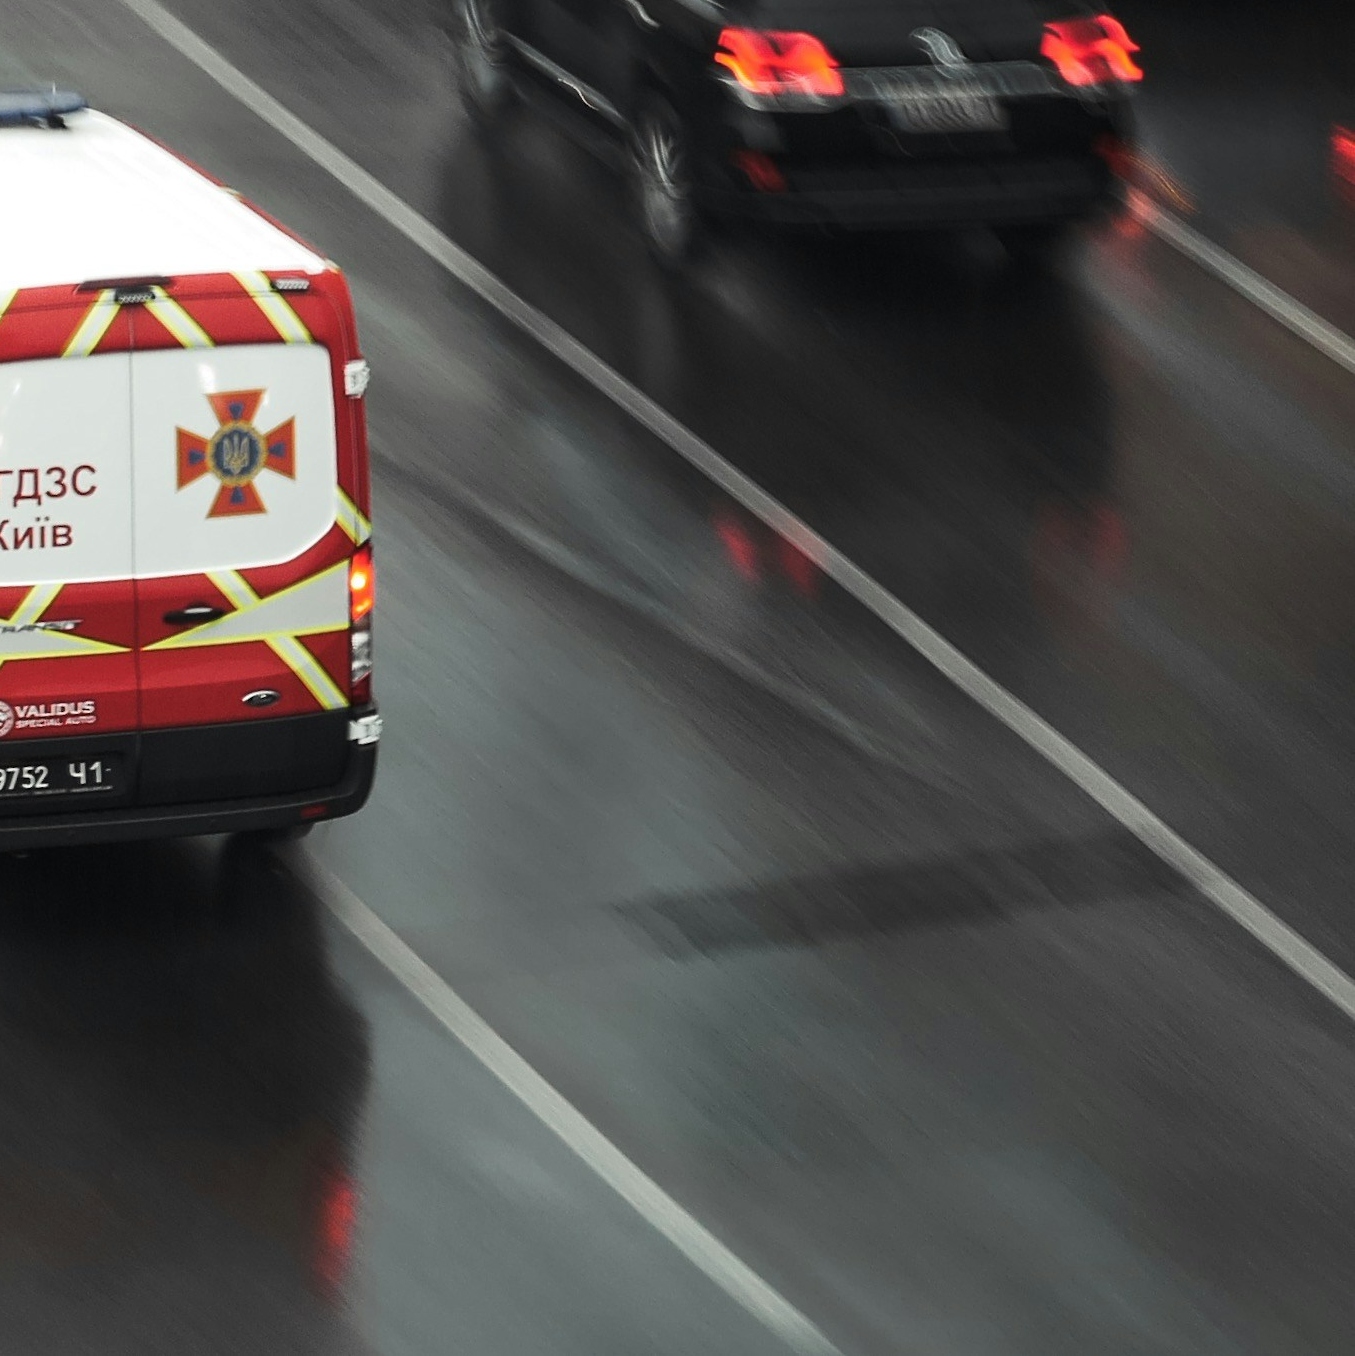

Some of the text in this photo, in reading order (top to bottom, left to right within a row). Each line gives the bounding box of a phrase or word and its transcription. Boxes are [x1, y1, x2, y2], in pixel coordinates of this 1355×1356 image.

[14, 700, 96, 718] VALIDUS
[15, 714, 96, 729] SPECIAL AUTO
